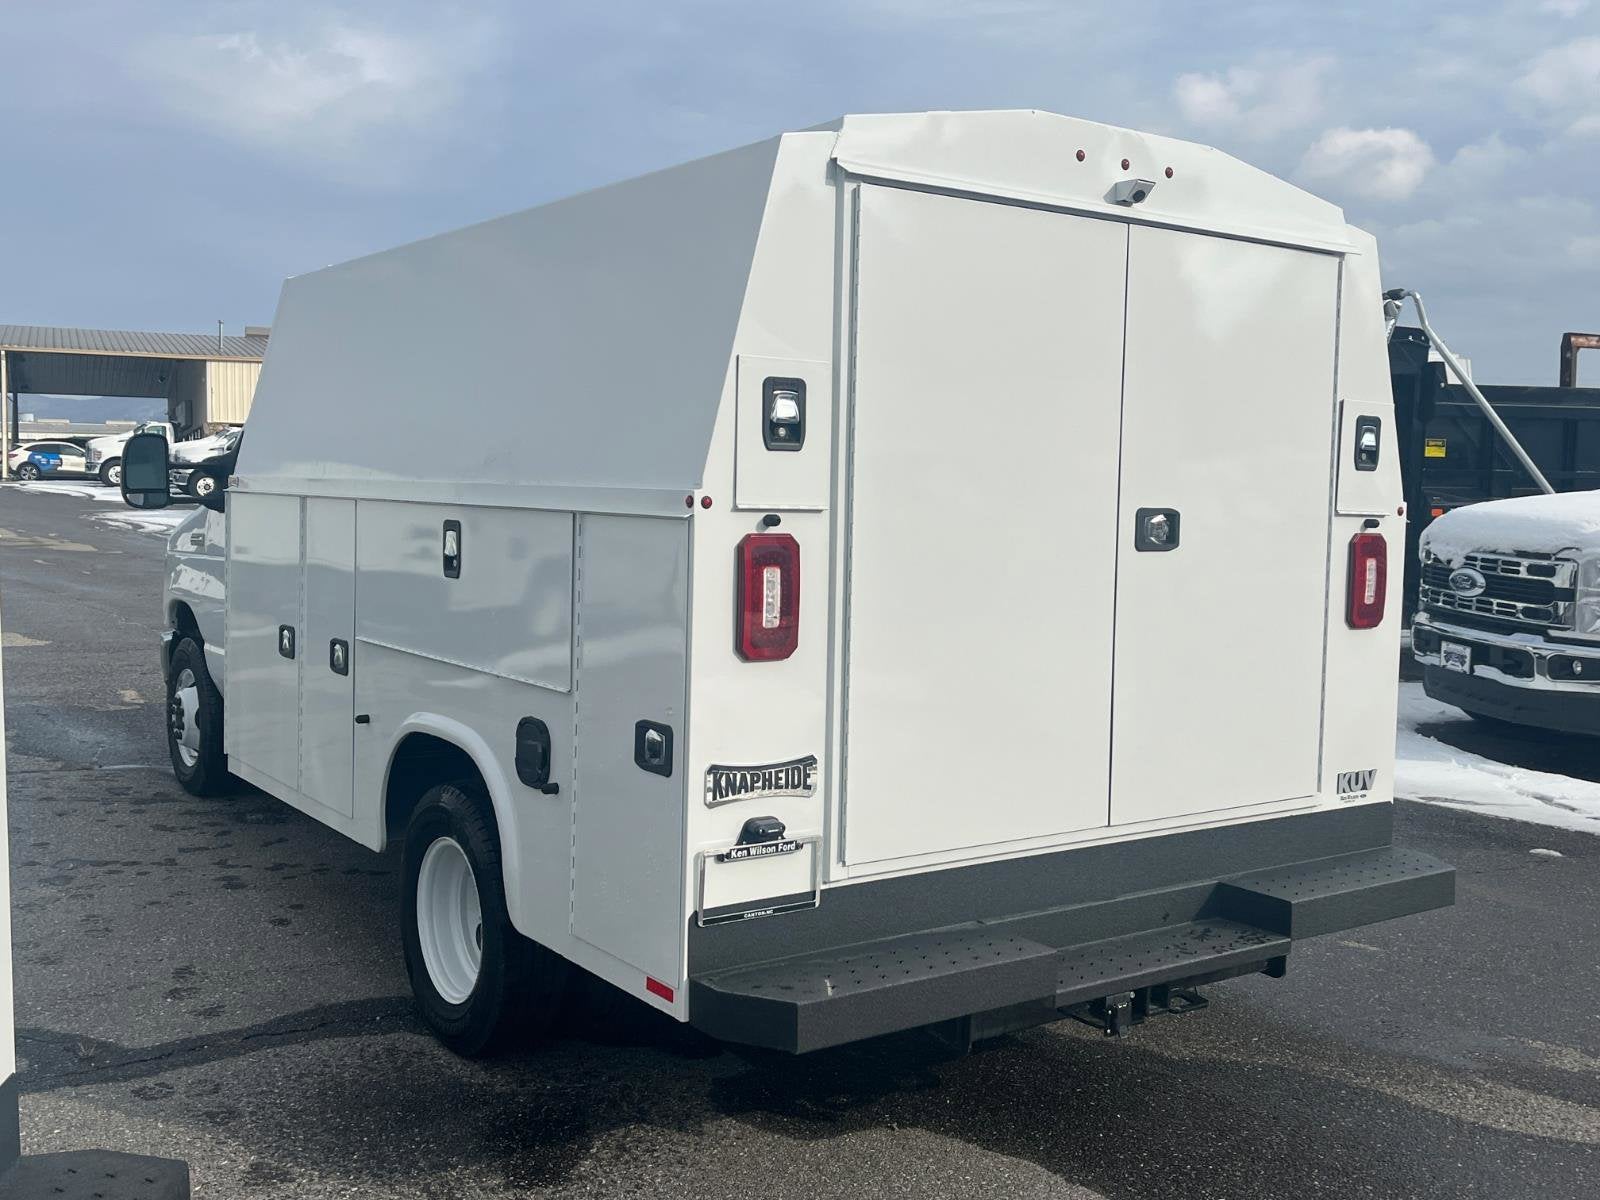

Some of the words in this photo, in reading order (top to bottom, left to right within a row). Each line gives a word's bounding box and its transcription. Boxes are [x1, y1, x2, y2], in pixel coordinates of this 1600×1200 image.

[712, 761, 813, 801] KNAPHEIDE
[1336, 769, 1378, 794] KUV
[731, 849, 747, 858] Ken
[750, 846, 776, 856] Wilson
[778, 840, 796, 852] Ford
